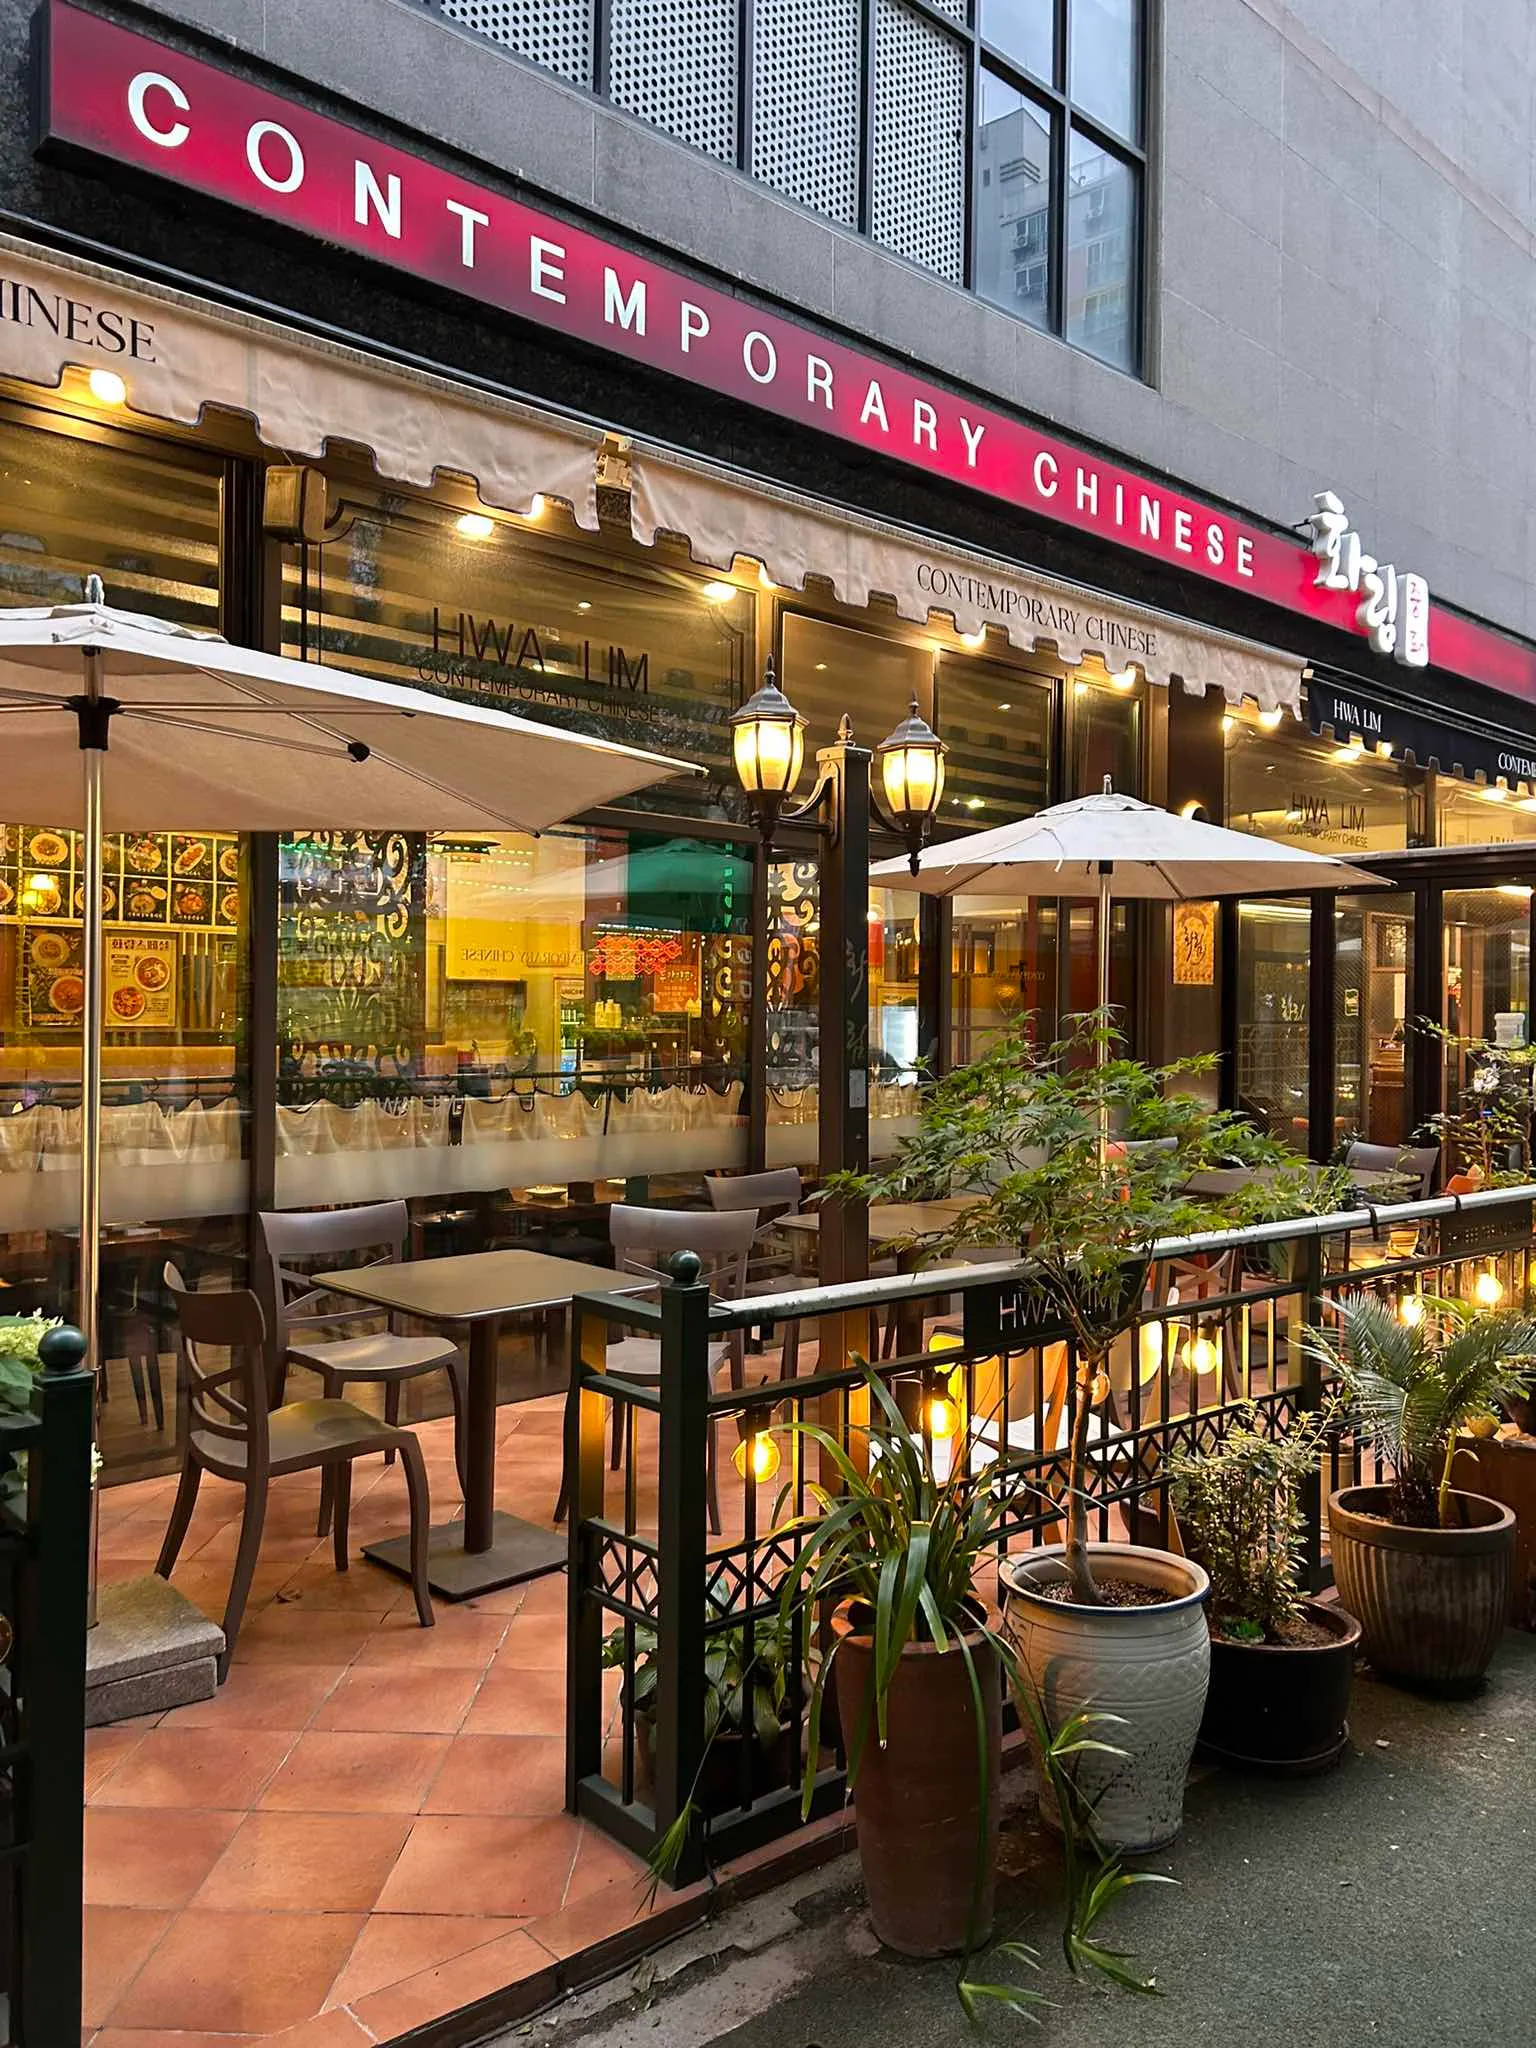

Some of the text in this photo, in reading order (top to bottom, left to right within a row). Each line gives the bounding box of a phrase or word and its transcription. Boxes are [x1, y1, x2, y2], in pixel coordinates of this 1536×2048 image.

[0, 278, 156, 363] INESE
[128, 71, 1254, 577] CONTEMPORARY CHINESE
[917, 564, 1156, 656] CONTEMPORARY CHINESE
[433, 607, 648, 694] HWA LIM
[418, 666, 581, 709] CONTEMPORARY
[1334, 698, 1382, 733] HWA LIM
[1291, 791, 1365, 832] HWA LIM
[999, 1291, 1062, 1331] HWA
